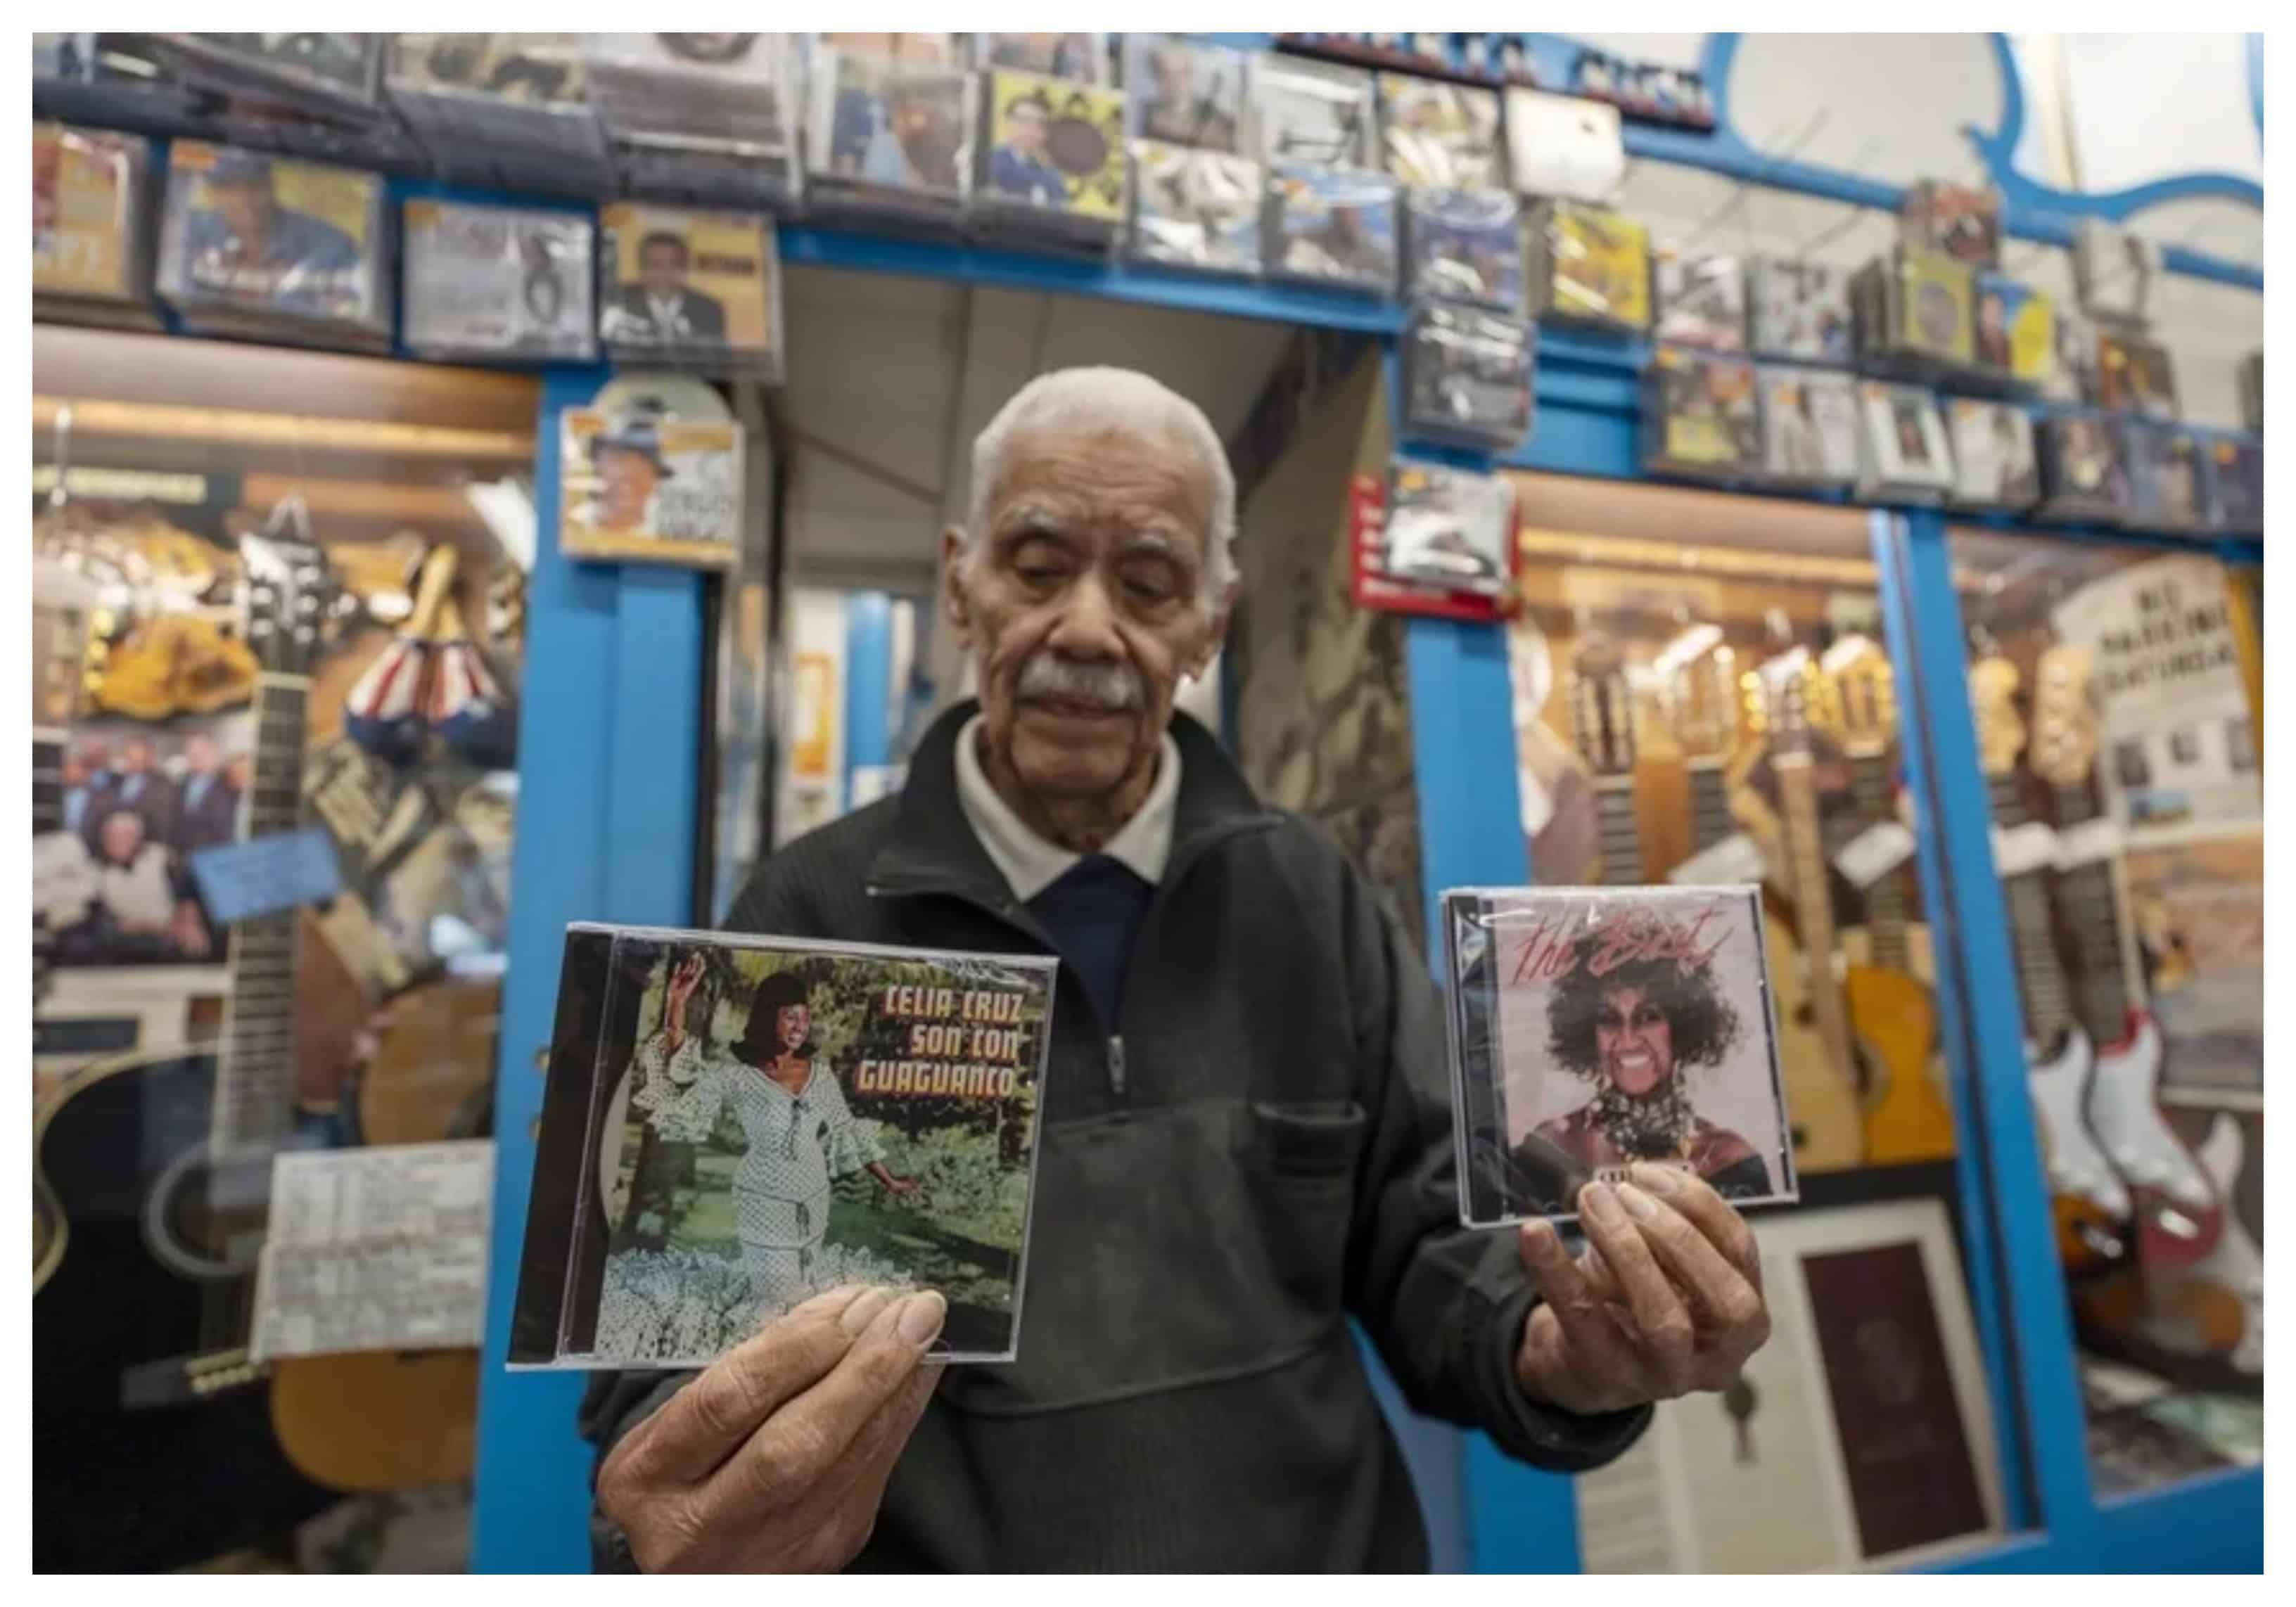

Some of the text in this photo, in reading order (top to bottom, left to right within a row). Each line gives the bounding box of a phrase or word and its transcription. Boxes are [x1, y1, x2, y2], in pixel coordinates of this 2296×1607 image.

[884, 984, 1023, 1022] CELIA CRUZ
[910, 1023, 1019, 1058] SON CON
[856, 1058, 1014, 1096] GUAGUANCO
